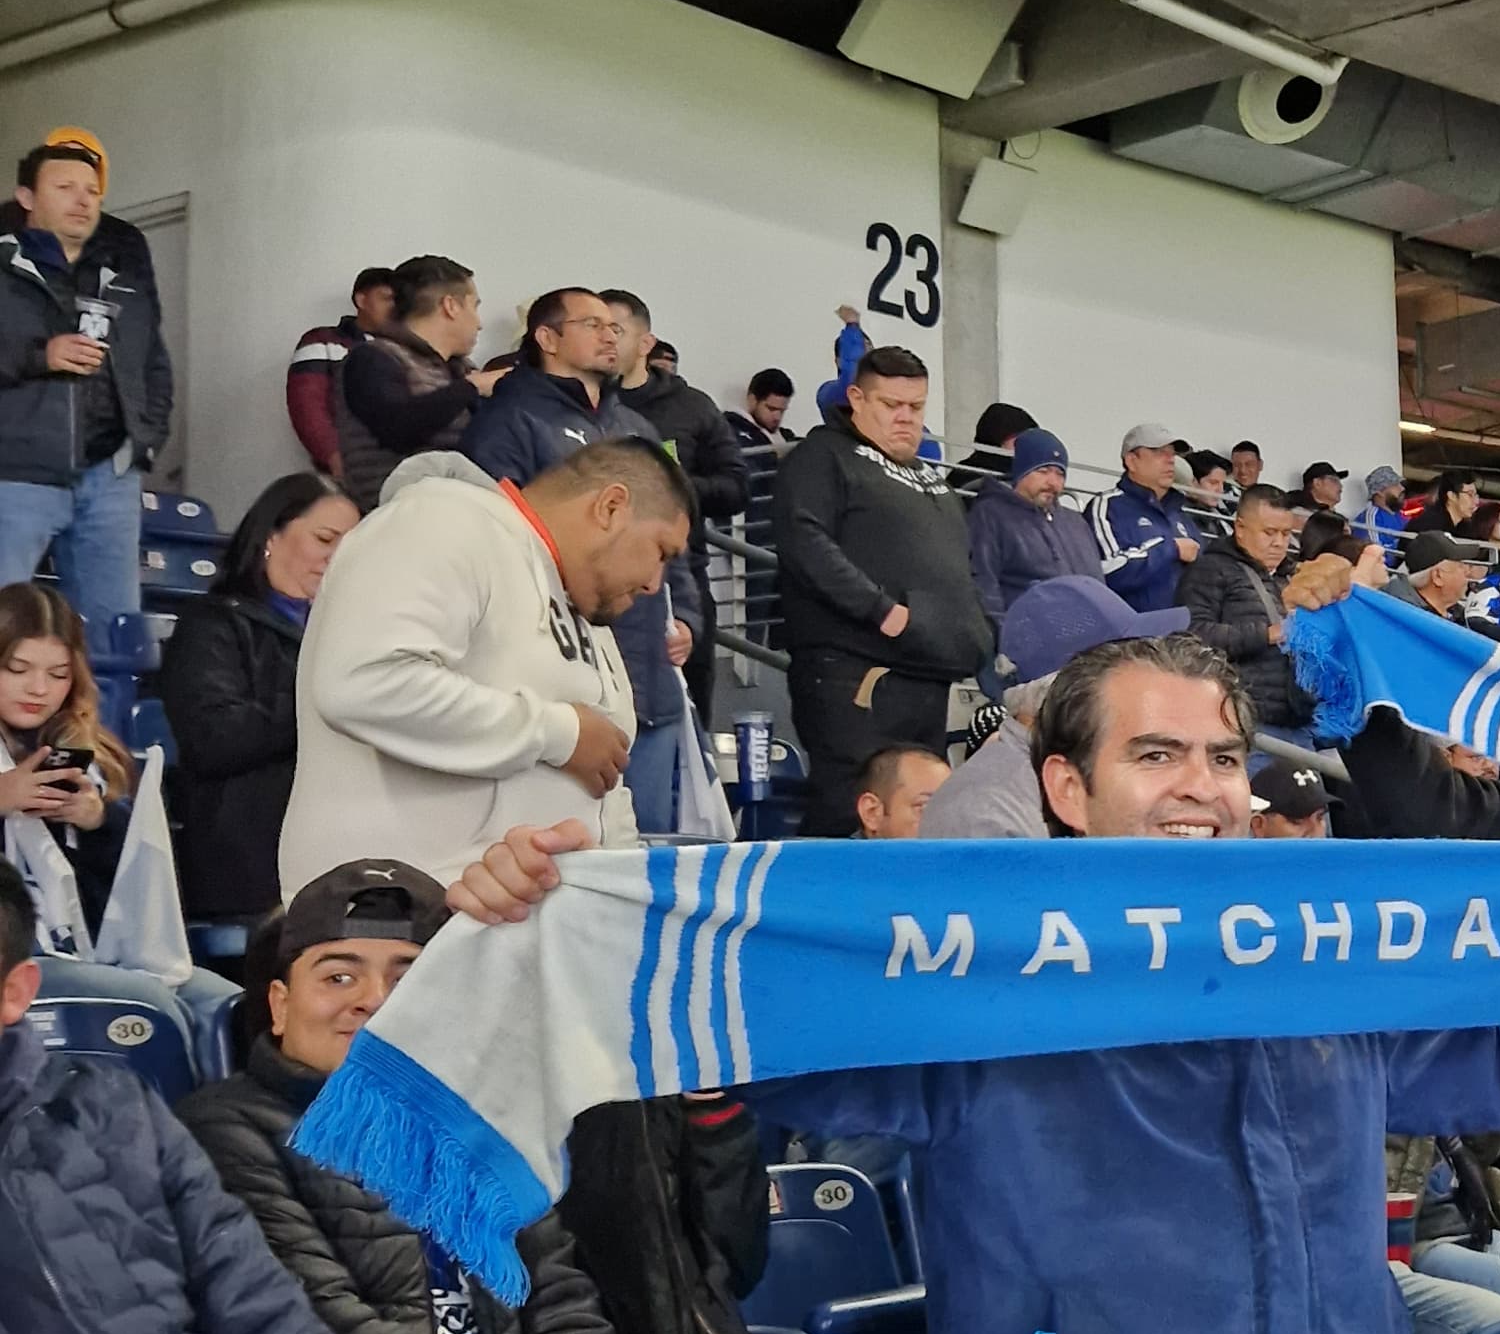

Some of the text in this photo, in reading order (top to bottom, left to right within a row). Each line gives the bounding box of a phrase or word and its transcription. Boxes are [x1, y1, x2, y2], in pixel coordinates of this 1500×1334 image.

[866, 222, 941, 329] 23
[115, 1021, 145, 1039] 30
[821, 1185, 848, 1207] 30
